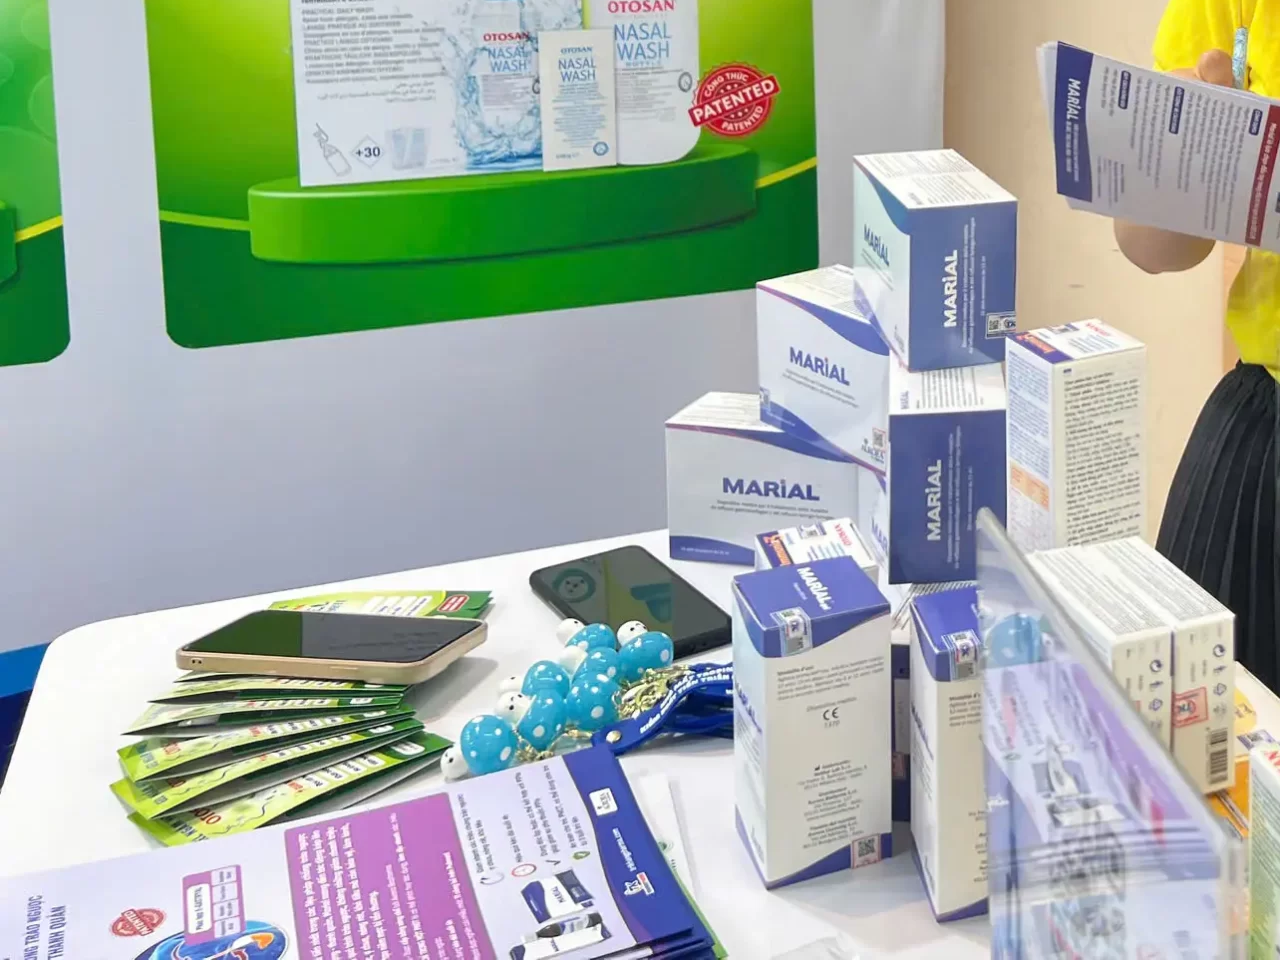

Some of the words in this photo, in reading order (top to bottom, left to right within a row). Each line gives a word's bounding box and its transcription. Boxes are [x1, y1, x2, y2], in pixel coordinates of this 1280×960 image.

[608, 0, 675, 13] OTOSAN
[483, 31, 530, 42] OTOSAN
[614, 22, 672, 41] NASAL
[617, 41, 670, 60] WASH
[490, 60, 527, 73] WASH
[559, 57, 597, 70] NASAL
[561, 71, 596, 82] WASH
[693, 79, 775, 123] PATENTED
[721, 106, 763, 131] PATENTED
[355, 146, 380, 158] +30
